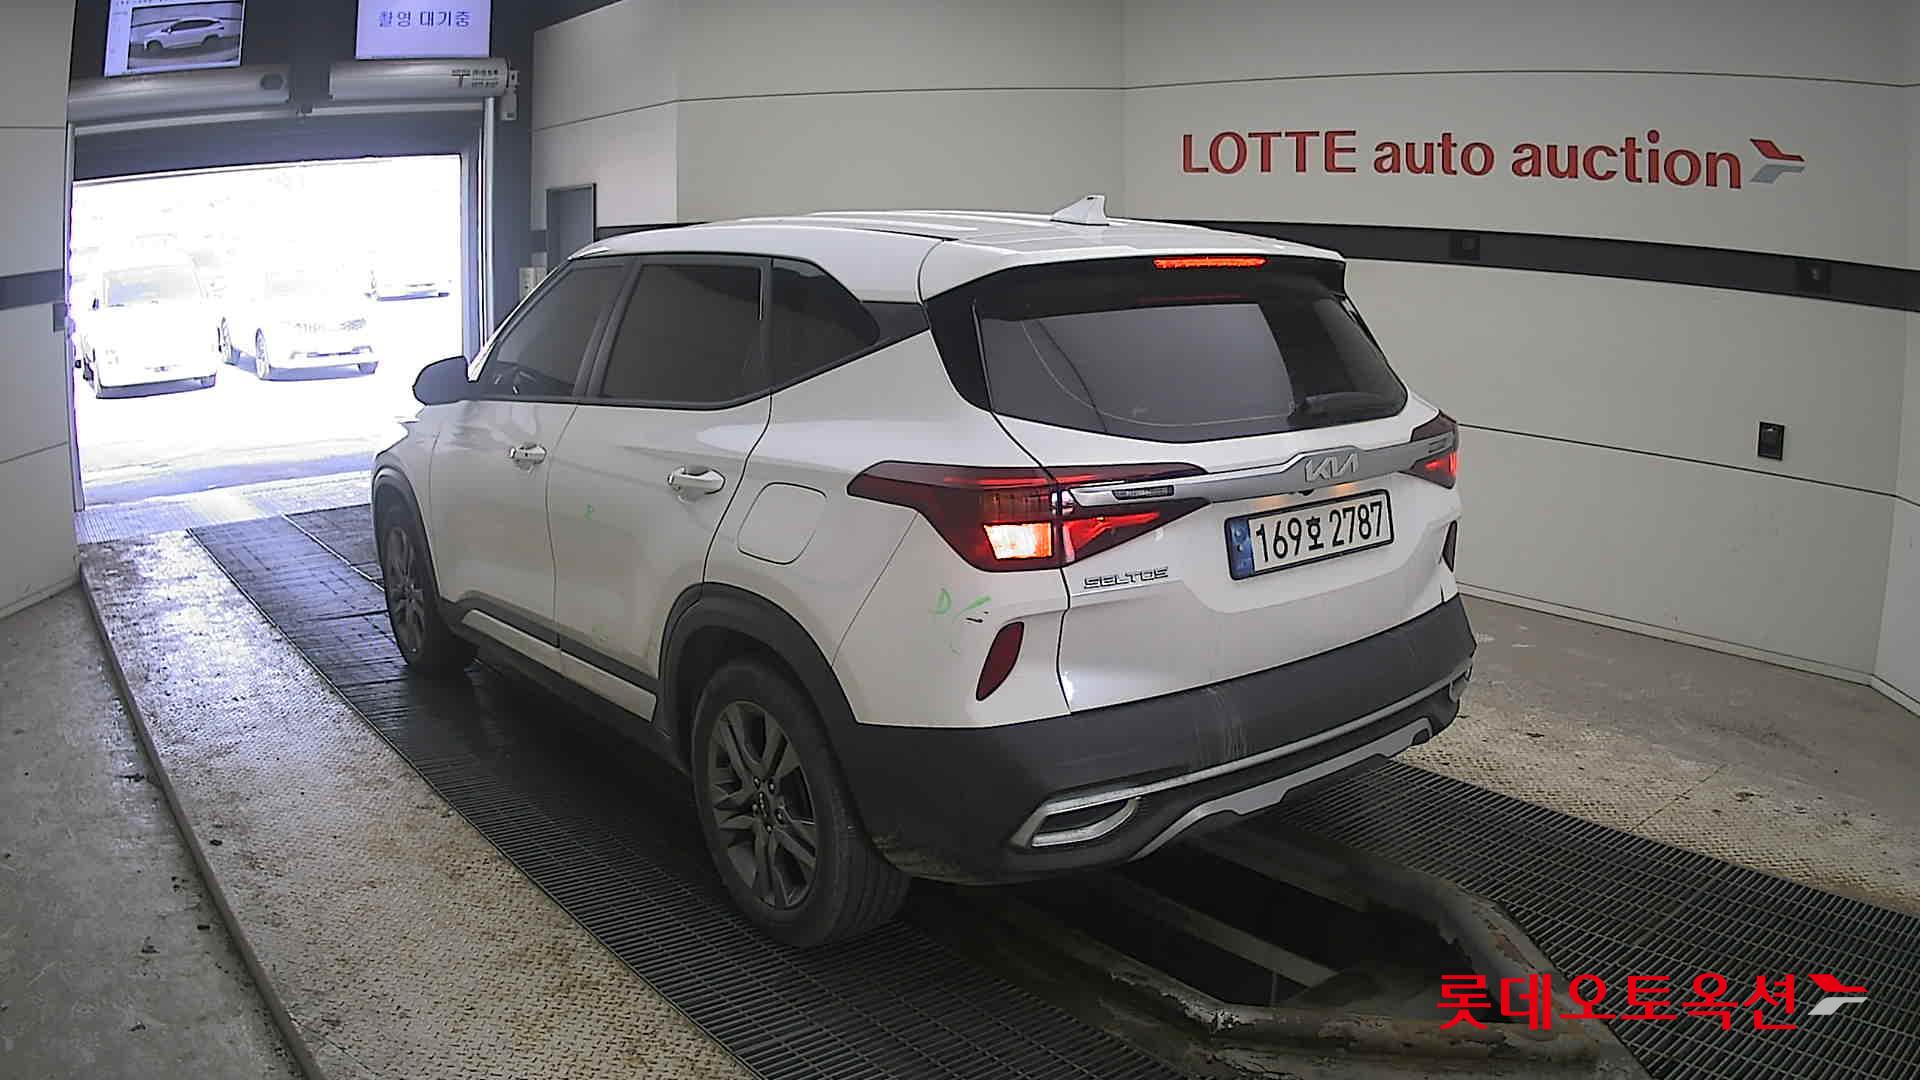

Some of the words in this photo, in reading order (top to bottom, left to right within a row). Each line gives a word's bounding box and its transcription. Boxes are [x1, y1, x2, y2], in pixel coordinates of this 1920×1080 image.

[379, 10, 411, 28] 촬영
[420, 10, 471, 28] 대기중
[1182, 130, 1357, 174] LOTTE
[1373, 132, 1494, 177] auto
[1511, 130, 1742, 190] auction
[1304, 452, 1359, 483] KIA
[1255, 515, 1324, 564] 169호
[1329, 500, 1383, 549] 2787
[1084, 566, 1169, 589] SELTOS
